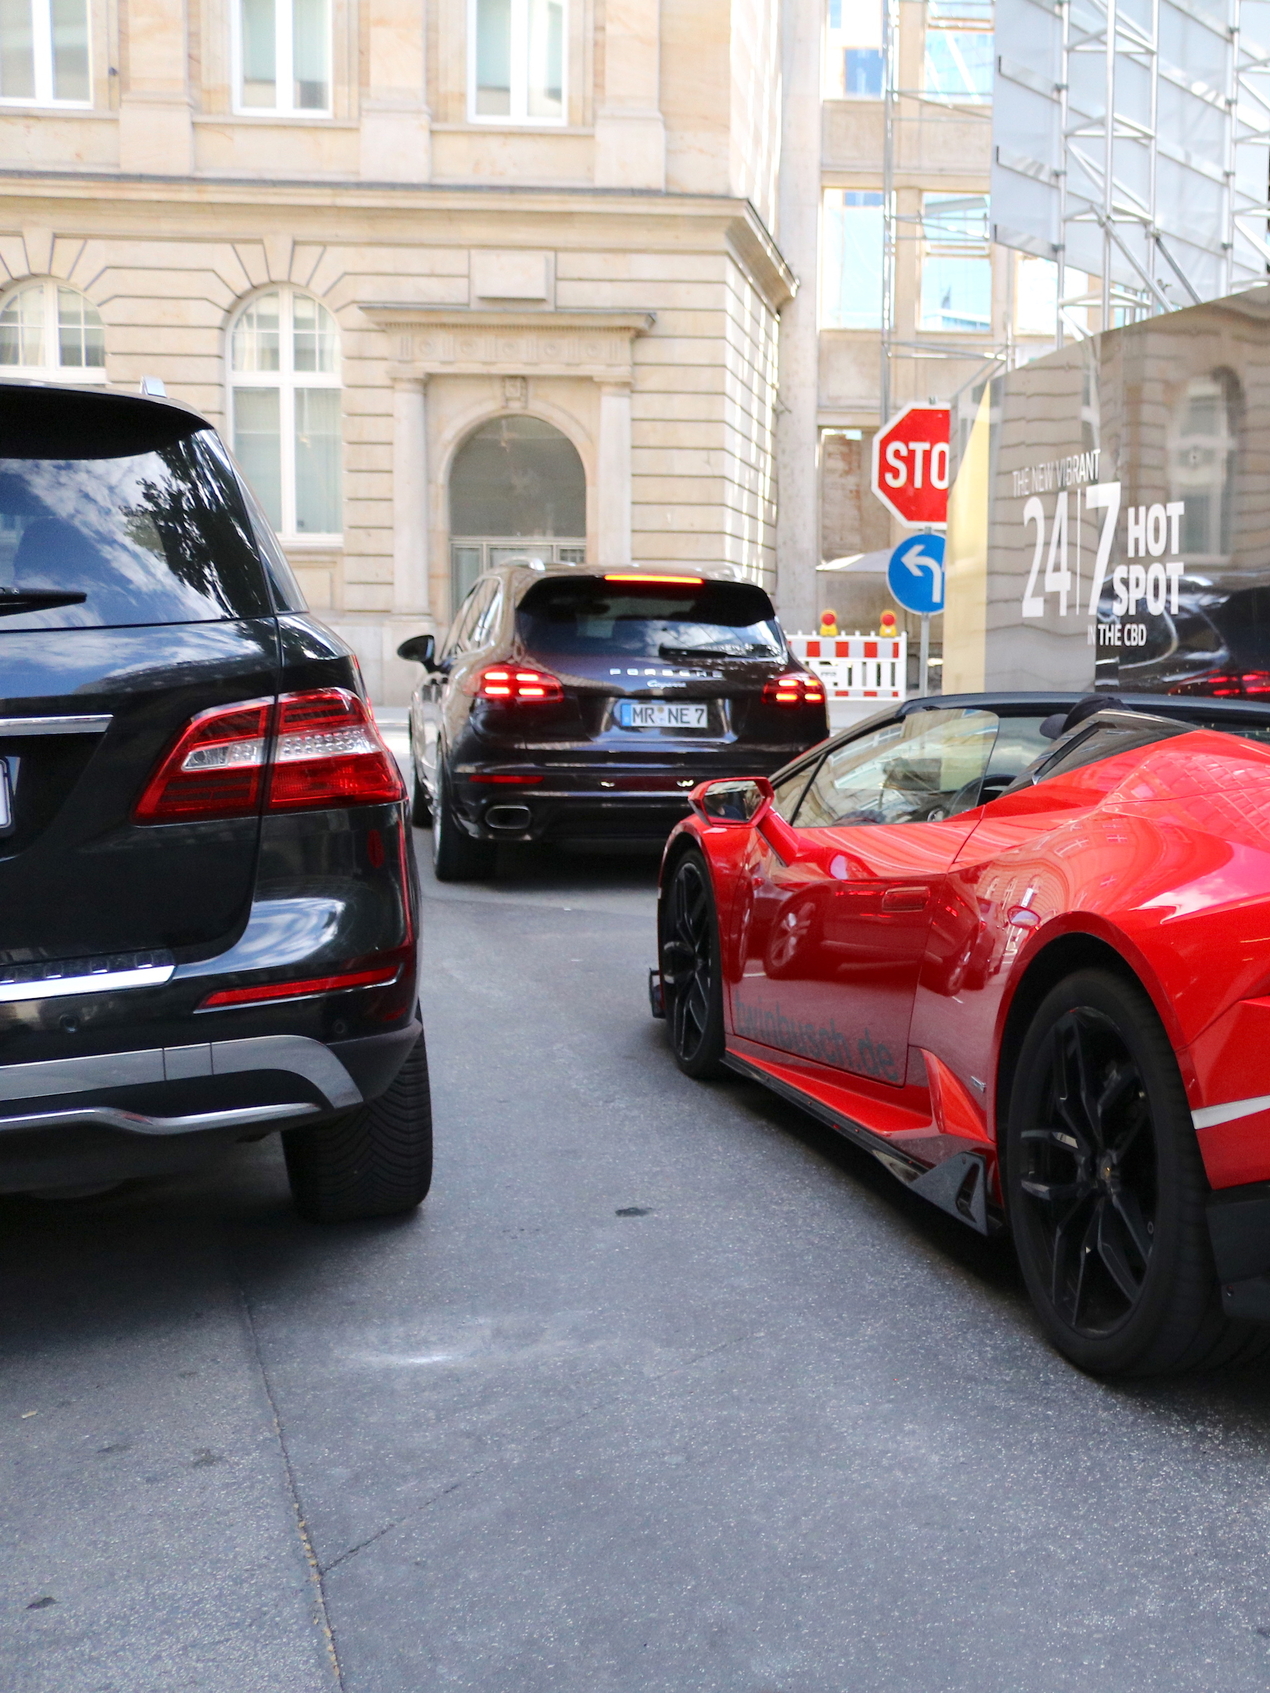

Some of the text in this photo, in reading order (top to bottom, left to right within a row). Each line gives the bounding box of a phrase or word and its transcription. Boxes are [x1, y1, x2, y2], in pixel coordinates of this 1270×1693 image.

[884, 441, 949, 490] STO
[1013, 449, 1101, 498] THE NEW VIBRANT
[1127, 501, 1185, 558] HOT
[1112, 562, 1185, 617] SPOT
[1098, 624, 1122, 646] THE
[1124, 624, 1147, 646] CBD
[632, 707, 705, 725] MR NE 7
